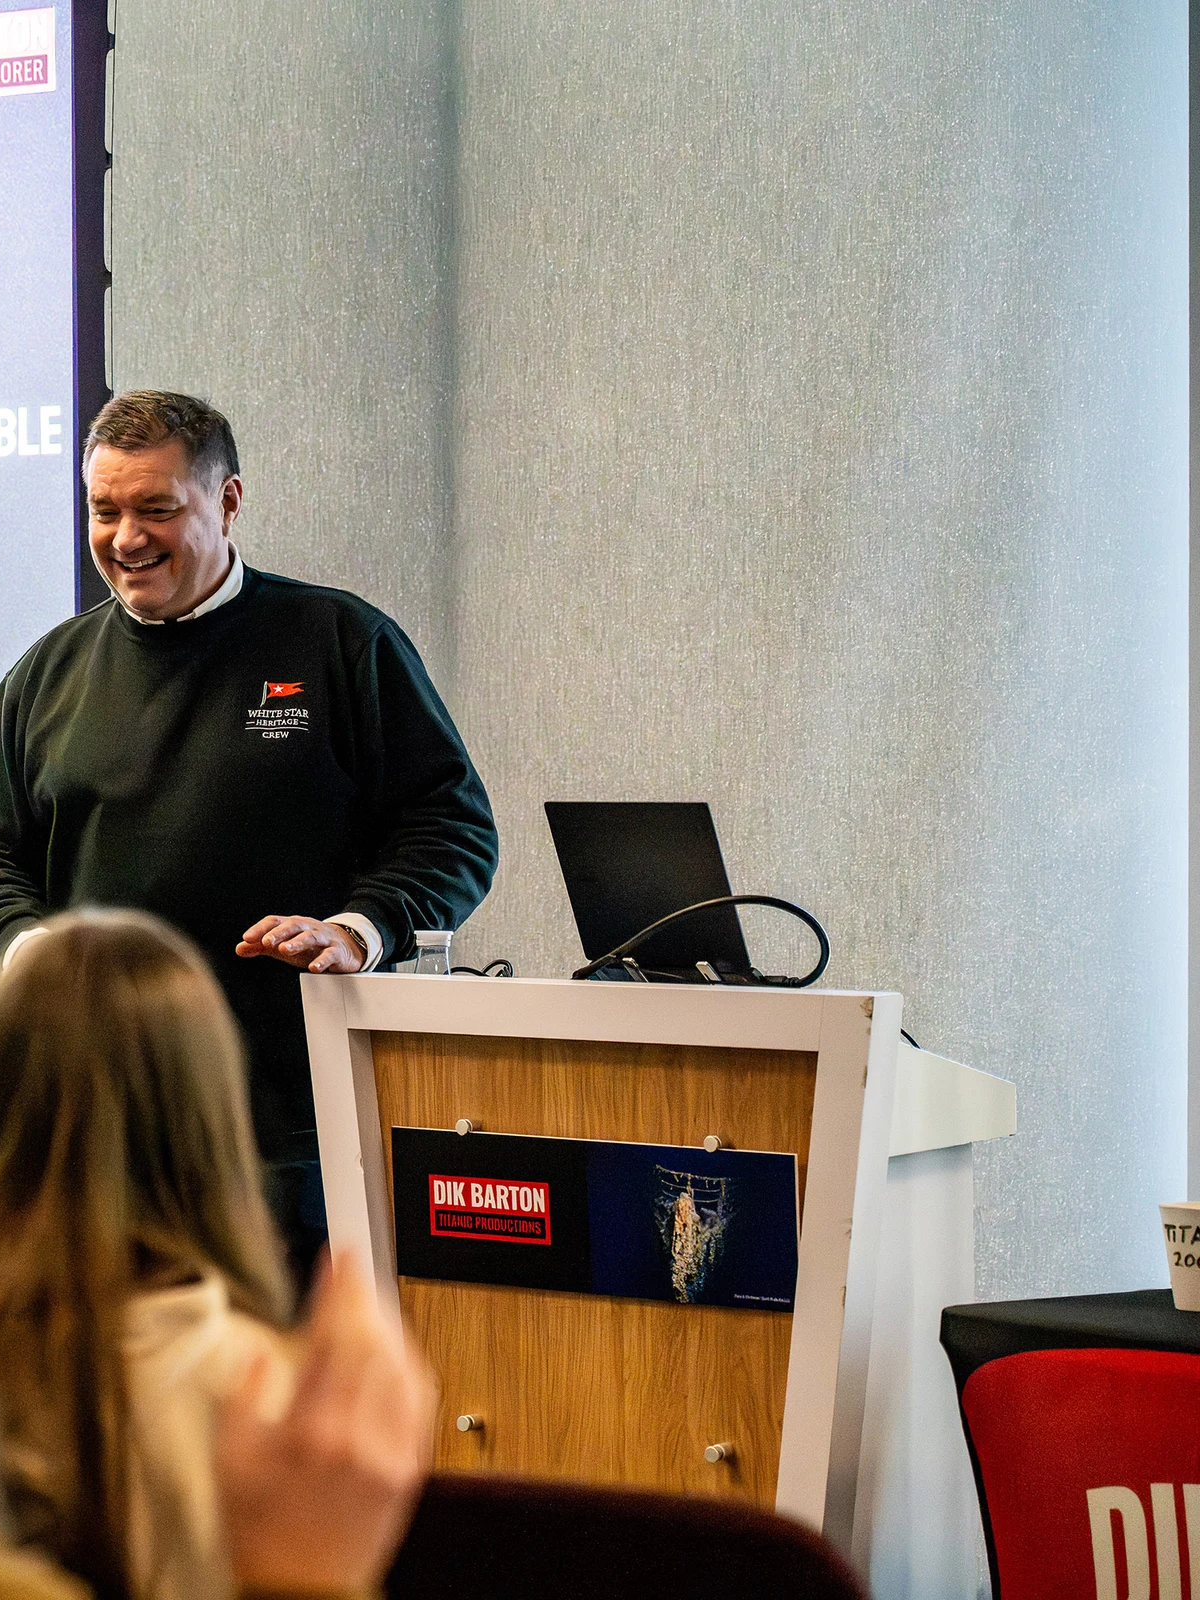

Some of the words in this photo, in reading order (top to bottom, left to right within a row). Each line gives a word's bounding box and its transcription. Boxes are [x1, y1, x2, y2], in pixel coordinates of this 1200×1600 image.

[247, 709, 283, 718] WHITE
[284, 708, 309, 719] STAR
[255, 718, 299, 727] HERITAGE
[262, 731, 290, 739] CREW
[433, 1179, 466, 1206] DIK
[470, 1183, 546, 1213] BARTON
[439, 1213, 473, 1229] TITANIC
[475, 1216, 542, 1235] PRODUCTIONS
